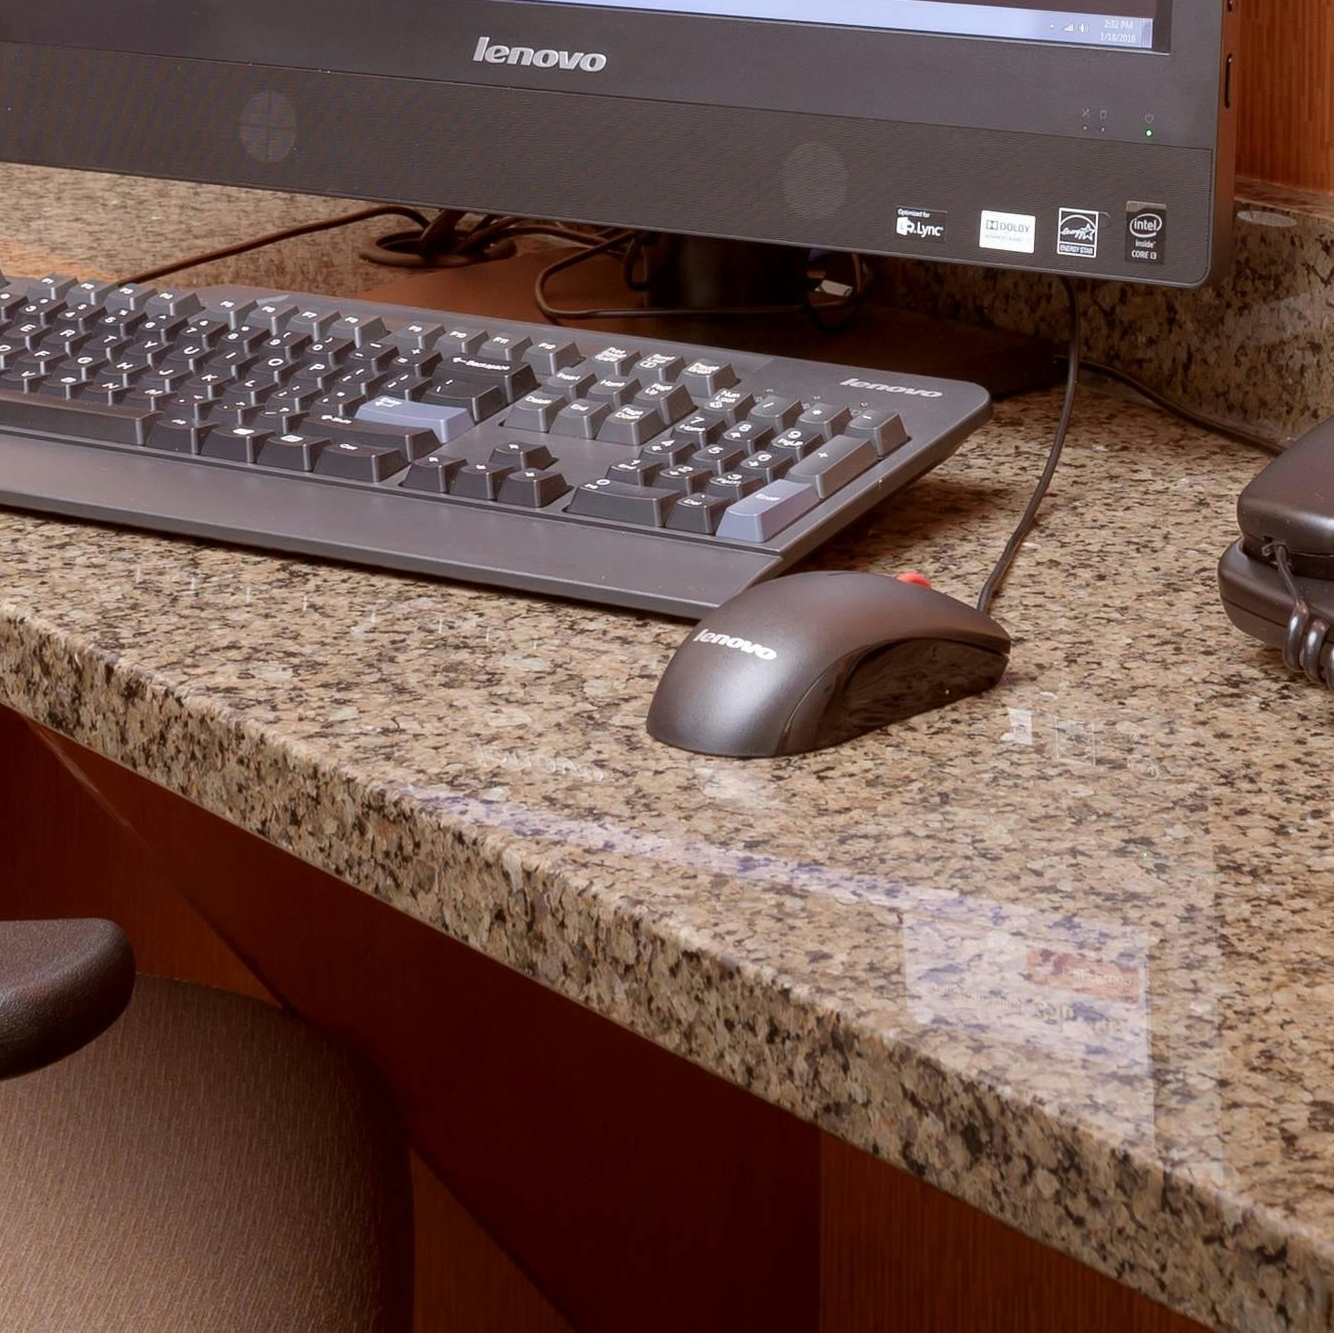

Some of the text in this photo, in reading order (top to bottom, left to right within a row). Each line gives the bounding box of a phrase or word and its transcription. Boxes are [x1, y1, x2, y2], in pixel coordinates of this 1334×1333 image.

[1120, 20, 1133, 29] PM
[473, 36, 607, 73] lenovo
[897, 208, 923, 217] Optimized
[1000, 222, 1030, 233] DOLBY
[1134, 218, 1157, 232] intel
[19, 324, 36, 333] E
[59, 329, 77, 338] R
[102, 335, 117, 343] T
[143, 341, 158, 349] Y
[183, 346, 200, 355] U
[116, 361, 134, 370] H
[309, 363, 326, 372] P
[200, 373, 218, 382] K
[244, 379, 257, 387] L
[839, 378, 943, 398] lenovo
[692, 628, 778, 660] lenovo
